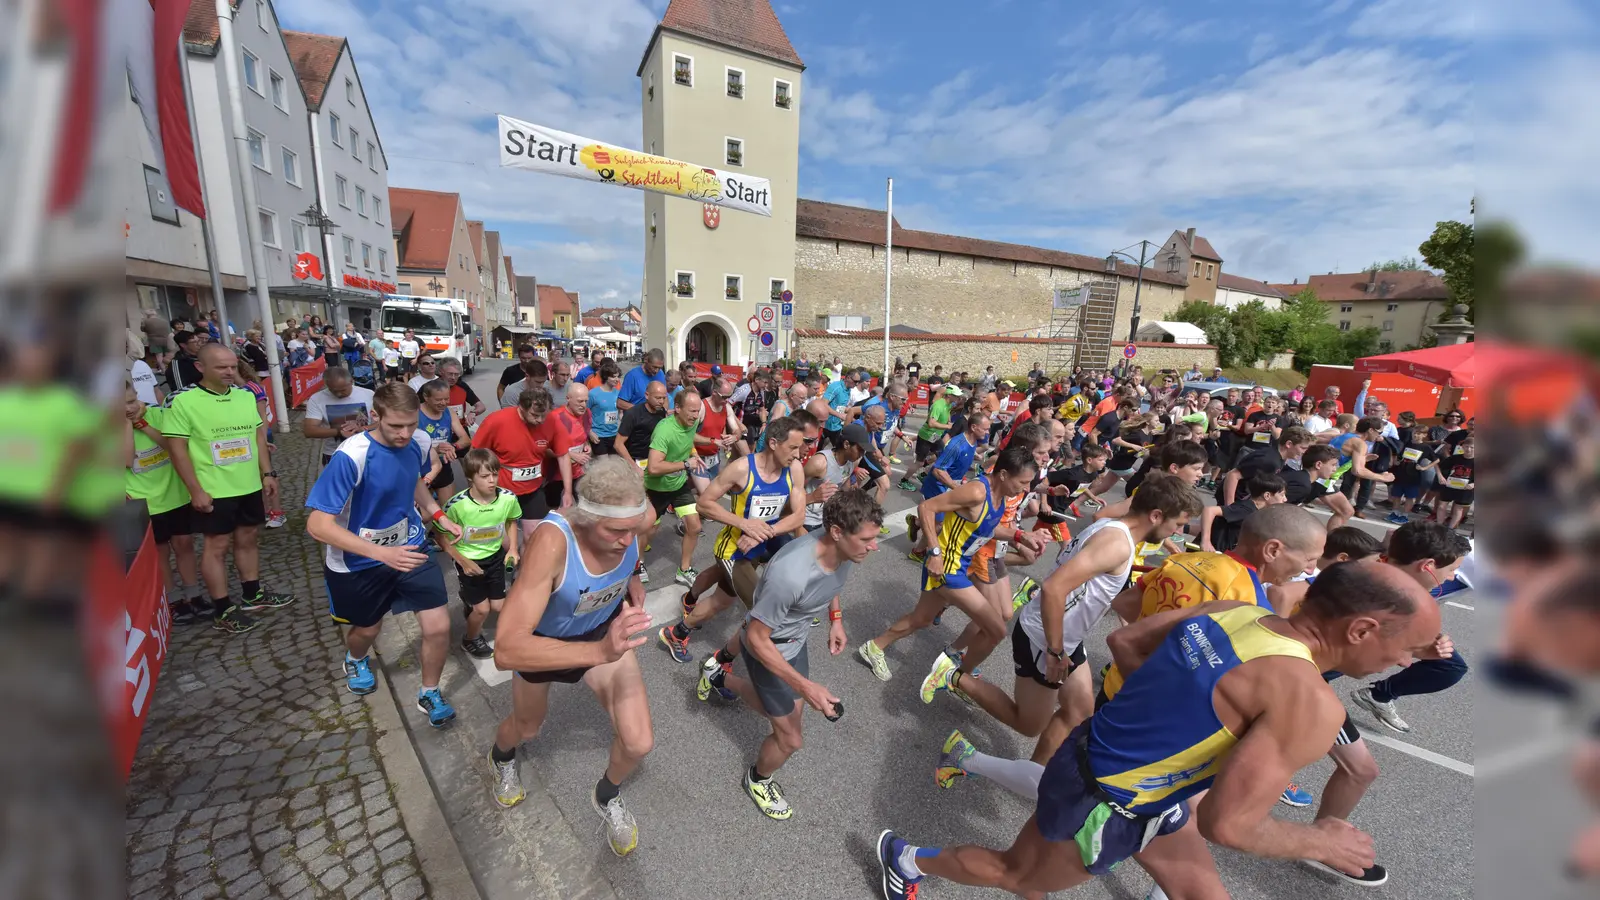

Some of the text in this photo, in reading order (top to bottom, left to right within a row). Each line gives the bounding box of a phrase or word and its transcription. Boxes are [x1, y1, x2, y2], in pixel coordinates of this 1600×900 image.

[505, 129, 578, 165] Start
[622, 170, 682, 190] Stadtlauf
[725, 178, 768, 206] Start
[763, 310, 772, 318] 20
[520, 467, 536, 476] 734
[759, 506, 778, 516] 727
[371, 533, 399, 546] 729
[1180, 635, 1201, 670] Hans Lang
